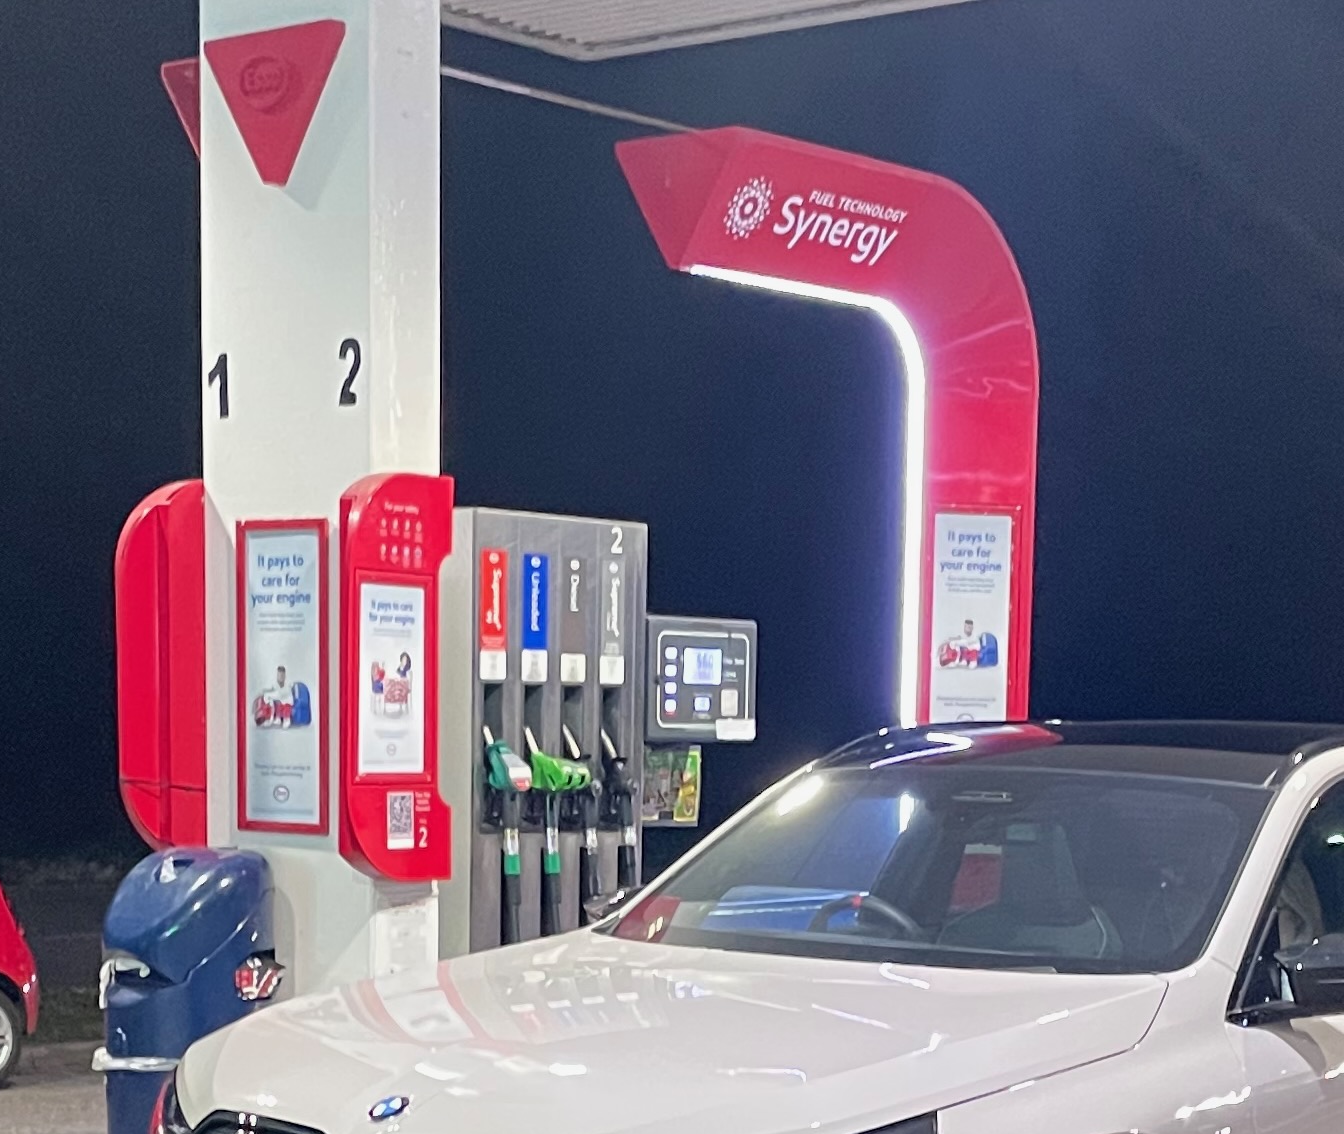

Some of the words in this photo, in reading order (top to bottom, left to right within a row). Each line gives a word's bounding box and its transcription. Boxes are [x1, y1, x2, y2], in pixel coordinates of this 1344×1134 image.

[809, 190, 834, 207] FUEL
[838, 196, 908, 224] TECHNOLOGY
[772, 194, 899, 266] Synergy
[339, 338, 361, 406] 2
[208, 352, 229, 419] 1
[610, 526, 623, 554] 2
[958, 534, 982, 544] pays
[985, 532, 996, 542] to
[257, 555, 265, 567] It
[267, 556, 290, 571] pays
[292, 554, 304, 567] to
[951, 548, 973, 557] care
[940, 562, 963, 573] your
[966, 560, 1002, 574] engine
[261, 576, 282, 587] care
[285, 573, 299, 586] for
[251, 594, 273, 608] your
[276, 590, 311, 607] engine
[418, 826, 429, 849] 2
